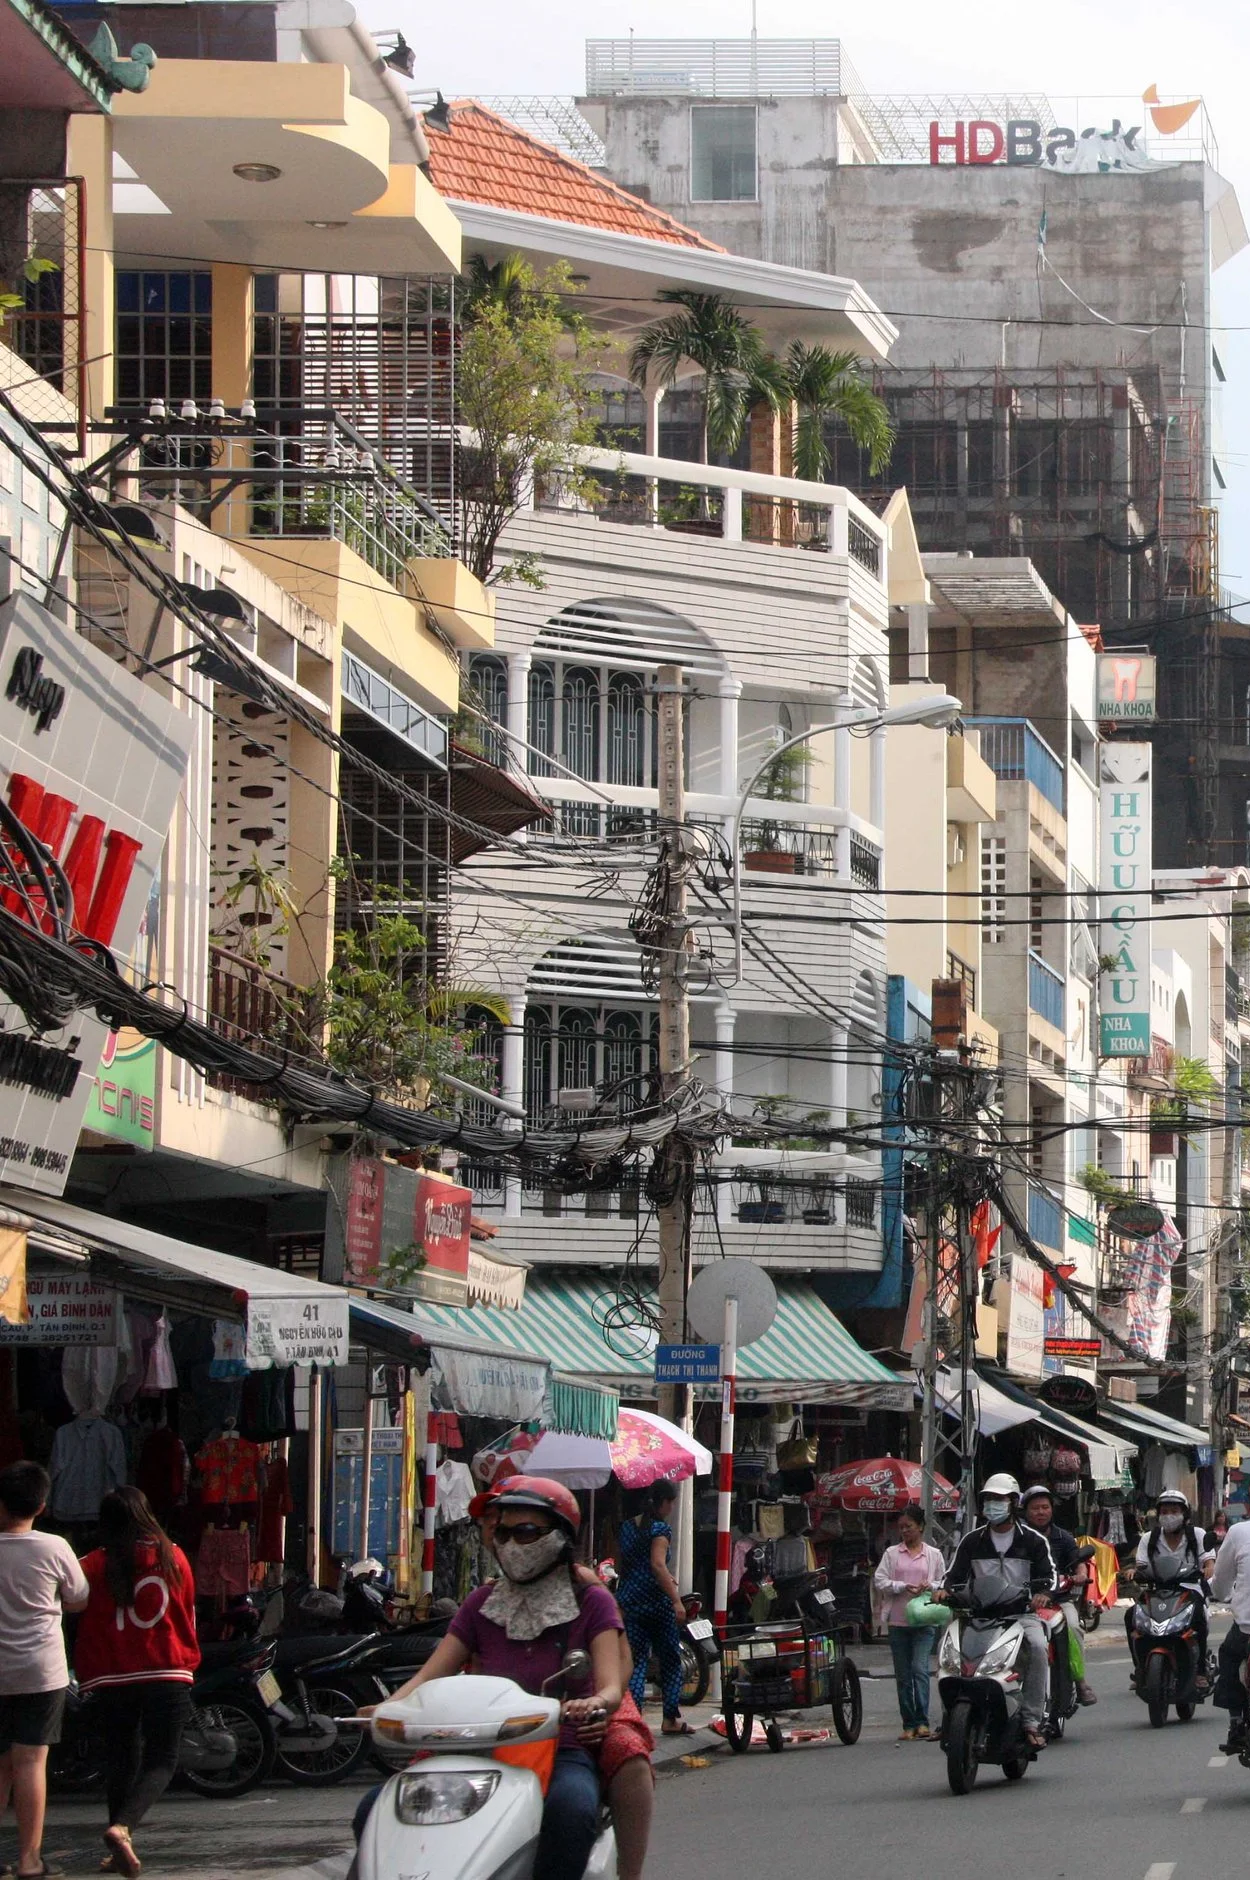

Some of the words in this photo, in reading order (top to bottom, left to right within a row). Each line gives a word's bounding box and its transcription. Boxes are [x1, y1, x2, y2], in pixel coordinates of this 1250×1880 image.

[1100, 703, 1121, 716] NHA
[1124, 703, 1152, 716] KHOA
[1104, 1016, 1132, 1031] NHA
[1110, 1037, 1146, 1051] KHOA
[303, 1304, 319, 1321] 41
[671, 1347, 706, 1360] ĐƯỜNG
